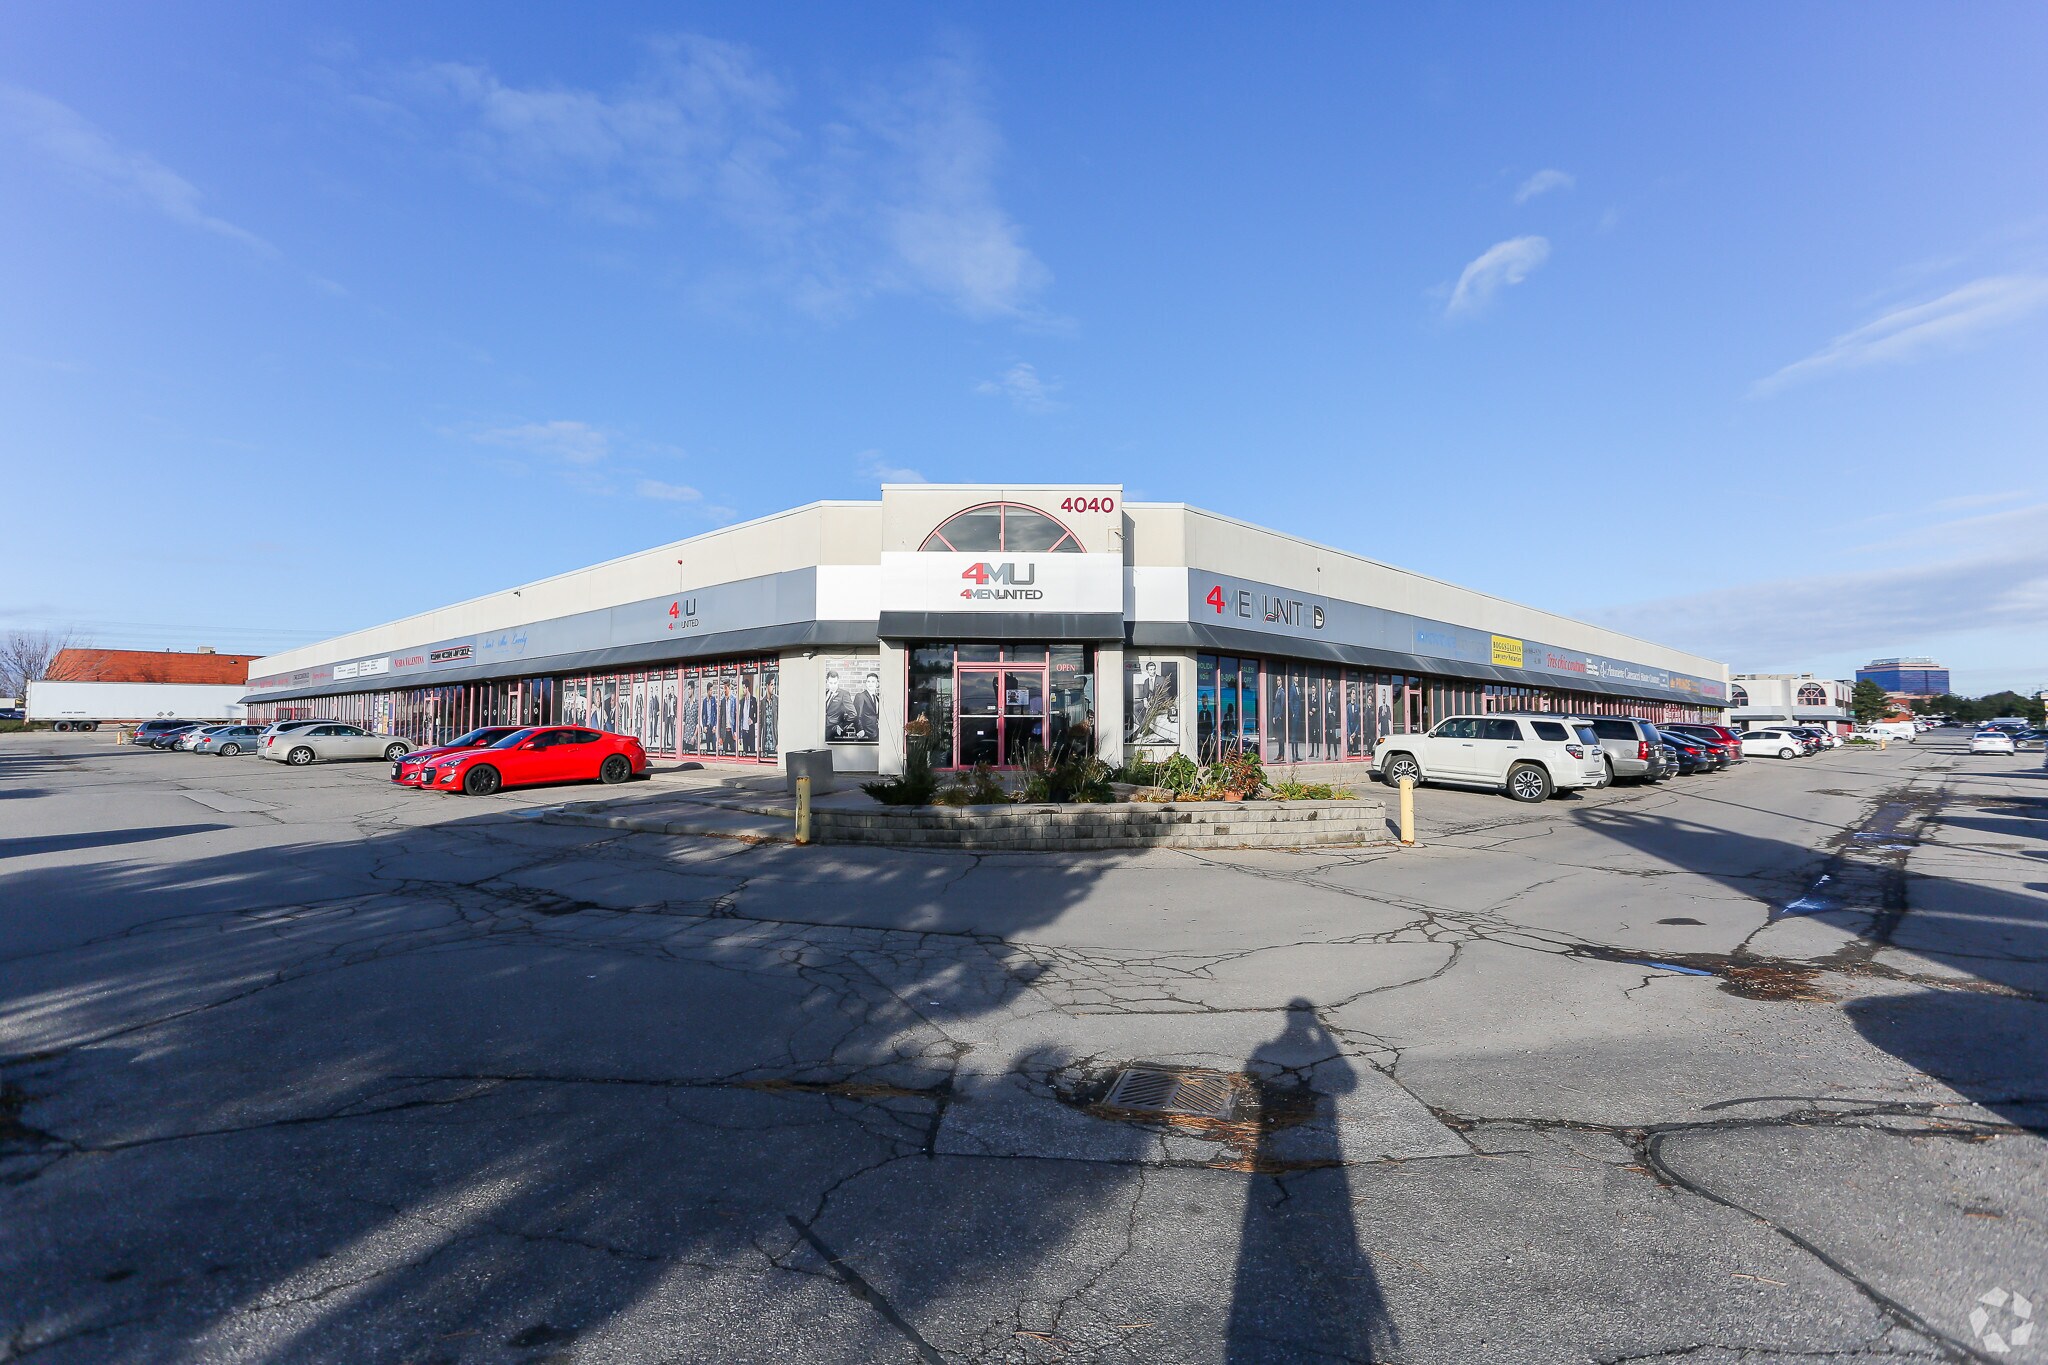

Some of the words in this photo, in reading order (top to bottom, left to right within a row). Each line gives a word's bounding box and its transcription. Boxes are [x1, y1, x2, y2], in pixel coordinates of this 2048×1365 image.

[1060, 497, 1115, 513] 4040
[962, 562, 1035, 585] 4MU
[1056, 663, 1076, 672] OPEN
